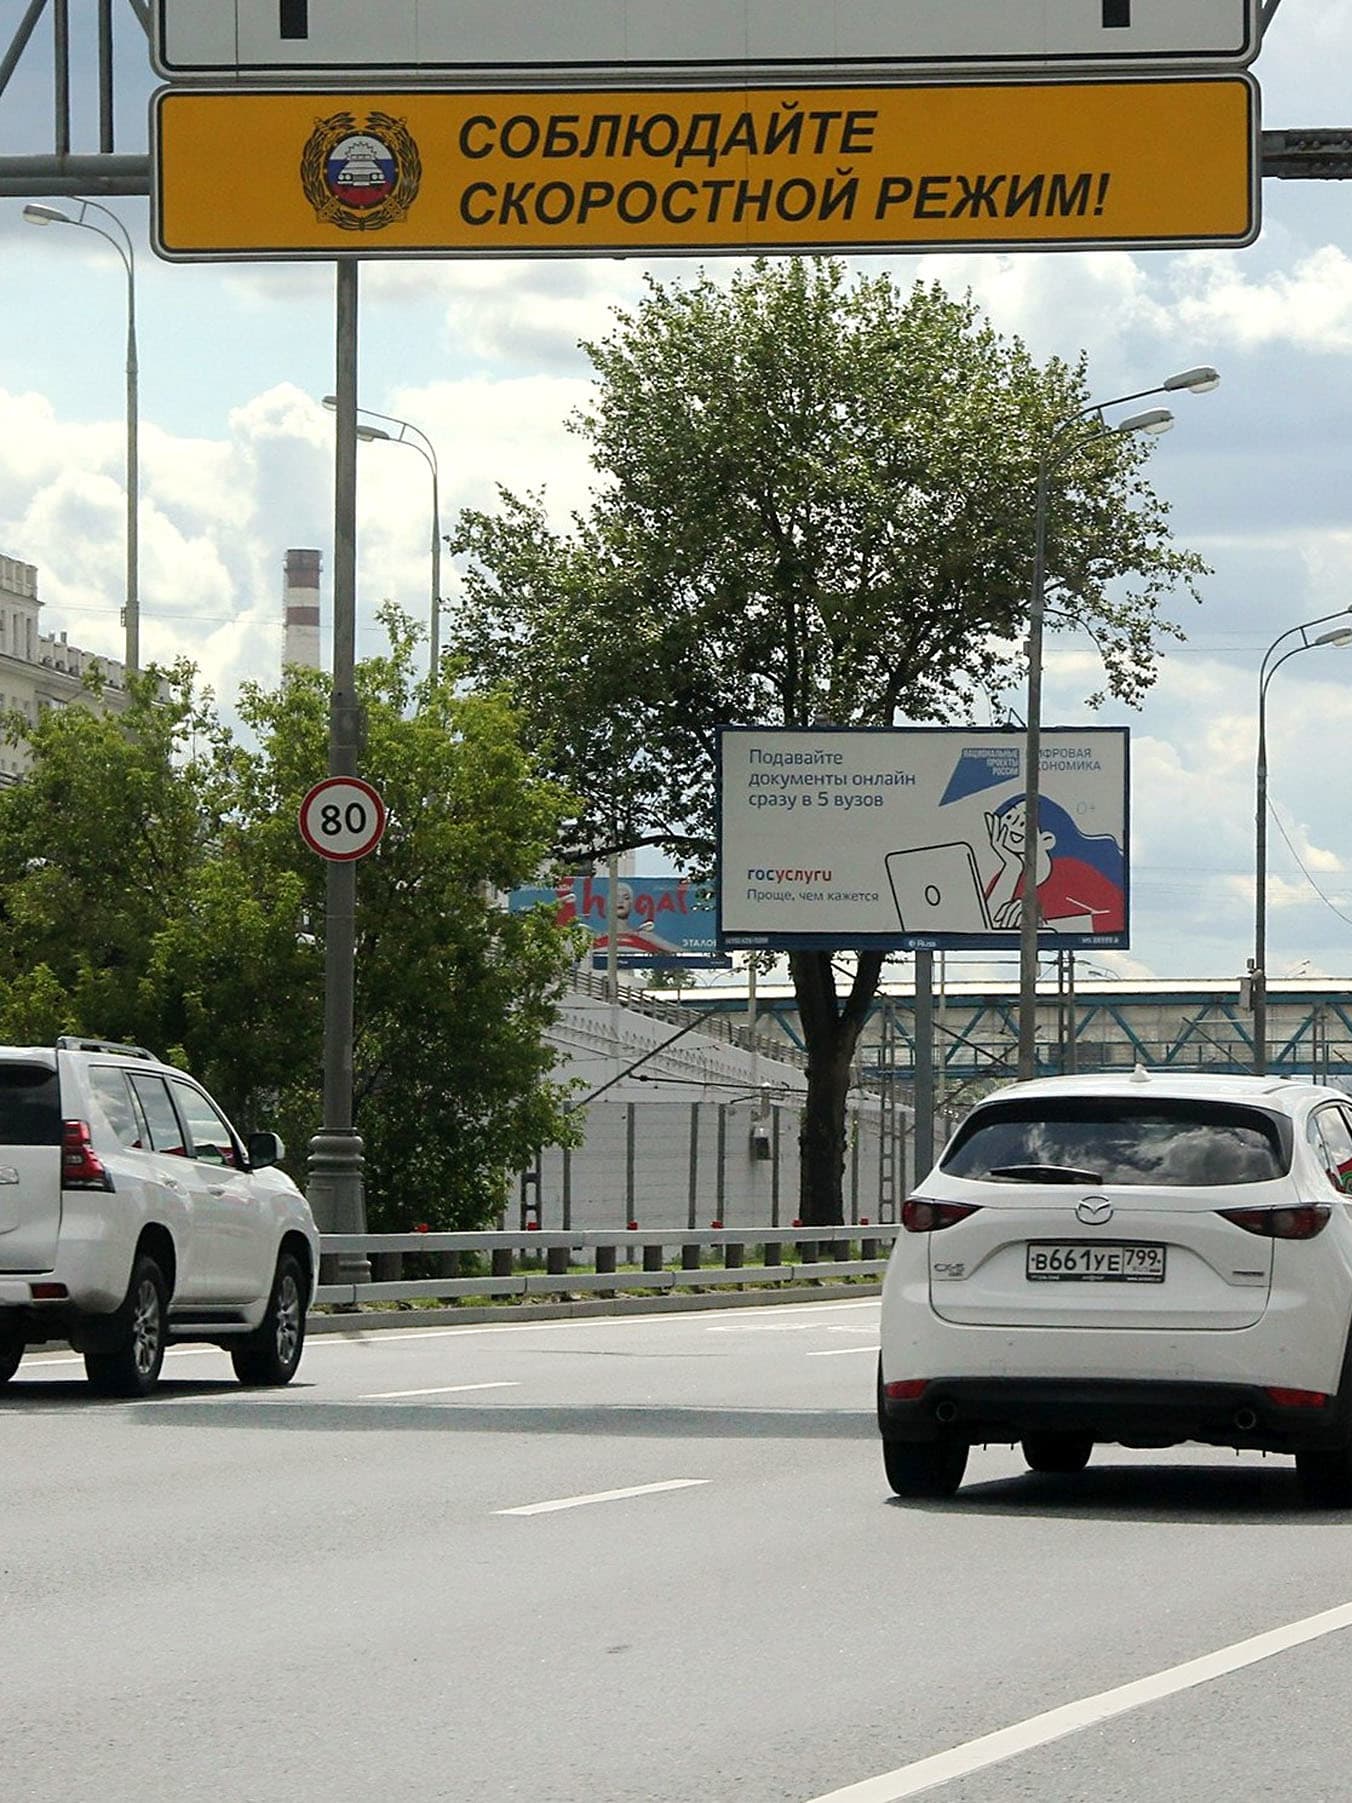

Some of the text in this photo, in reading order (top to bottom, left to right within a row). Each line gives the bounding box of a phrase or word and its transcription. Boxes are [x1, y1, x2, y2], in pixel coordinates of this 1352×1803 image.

[458, 104, 879, 169] СОБЛЮДАЙТЕ
[459, 167, 1111, 226] СКОРОСТНОЙ РЕЖИМ!
[749, 749, 844, 767] Подавайте
[748, 770, 916, 790] документы онлайн
[748, 790, 884, 811] сразу в 5 вузов
[320, 802, 367, 836] 80
[747, 868, 832, 885] госуслуги
[746, 888, 880, 903] Проще, чем кажется
[1035, 1249, 1158, 1272] В661УЕ 799
